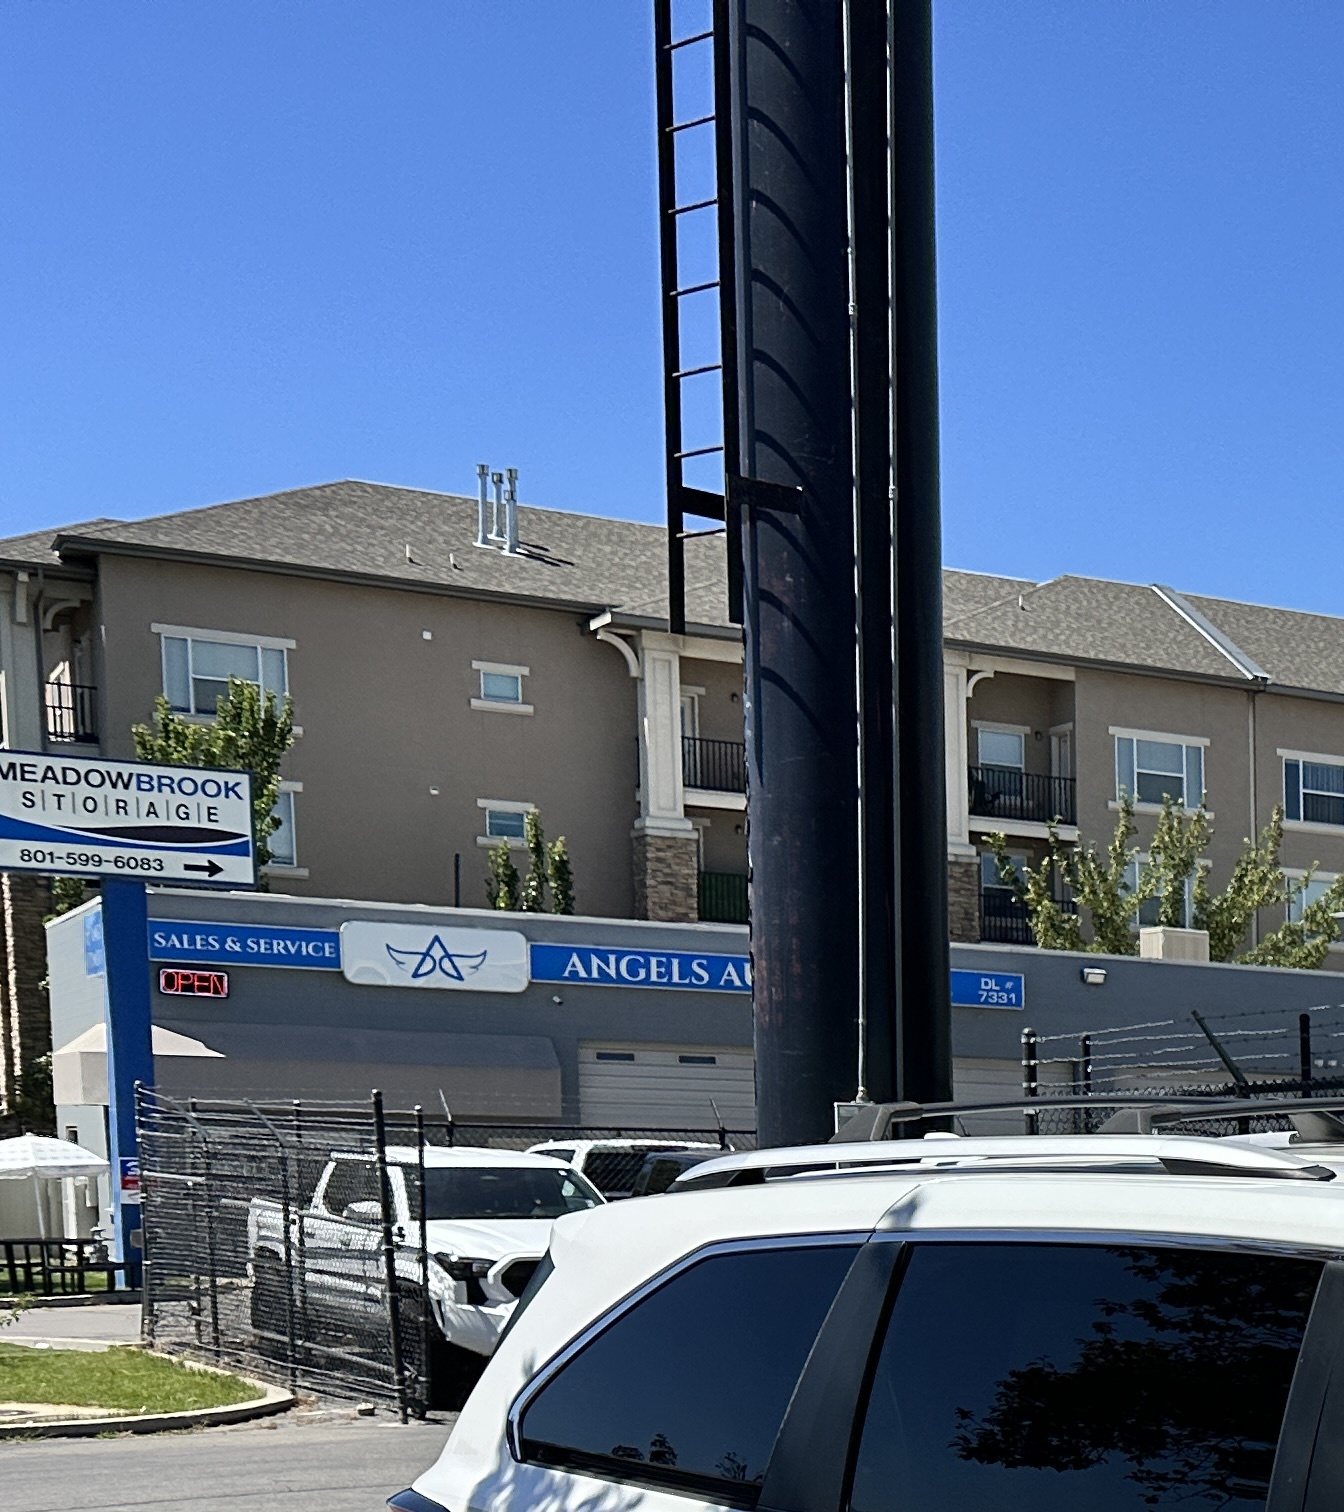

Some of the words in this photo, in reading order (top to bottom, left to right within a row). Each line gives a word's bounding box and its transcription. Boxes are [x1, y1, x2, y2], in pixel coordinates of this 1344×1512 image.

[0, 762, 243, 800] MEADOWBROOK
[20, 848, 164, 872] 801-599-6083
[153, 931, 219, 951] SALES
[224, 935, 242, 953] &
[247, 937, 336, 958] SERVICE
[562, 951, 710, 985] ANGELS
[162, 970, 226, 997] OPEN
[978, 990, 1016, 1004] 7331
[980, 977, 1001, 991] DL
